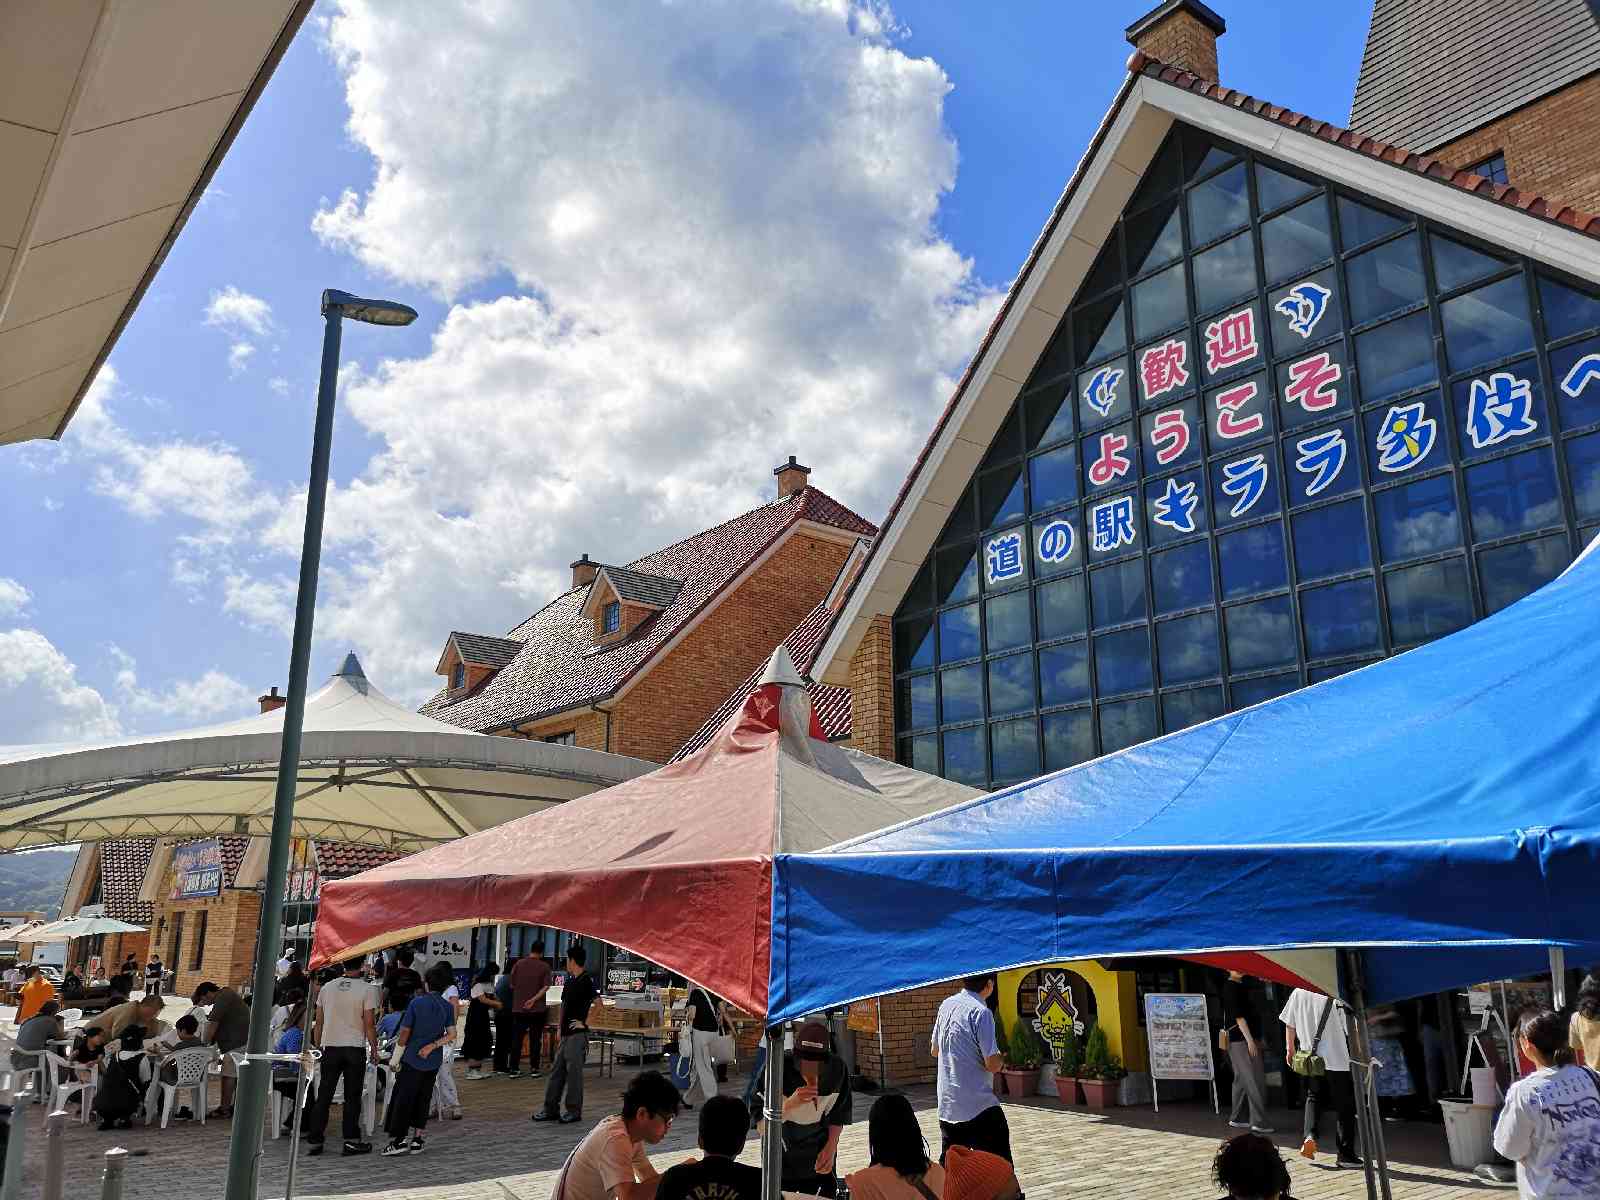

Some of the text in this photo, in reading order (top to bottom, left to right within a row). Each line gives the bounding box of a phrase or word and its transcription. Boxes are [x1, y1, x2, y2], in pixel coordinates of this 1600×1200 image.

[1140, 306, 1260, 401] 歓迎
[1088, 351, 1342, 487] ようこそ
